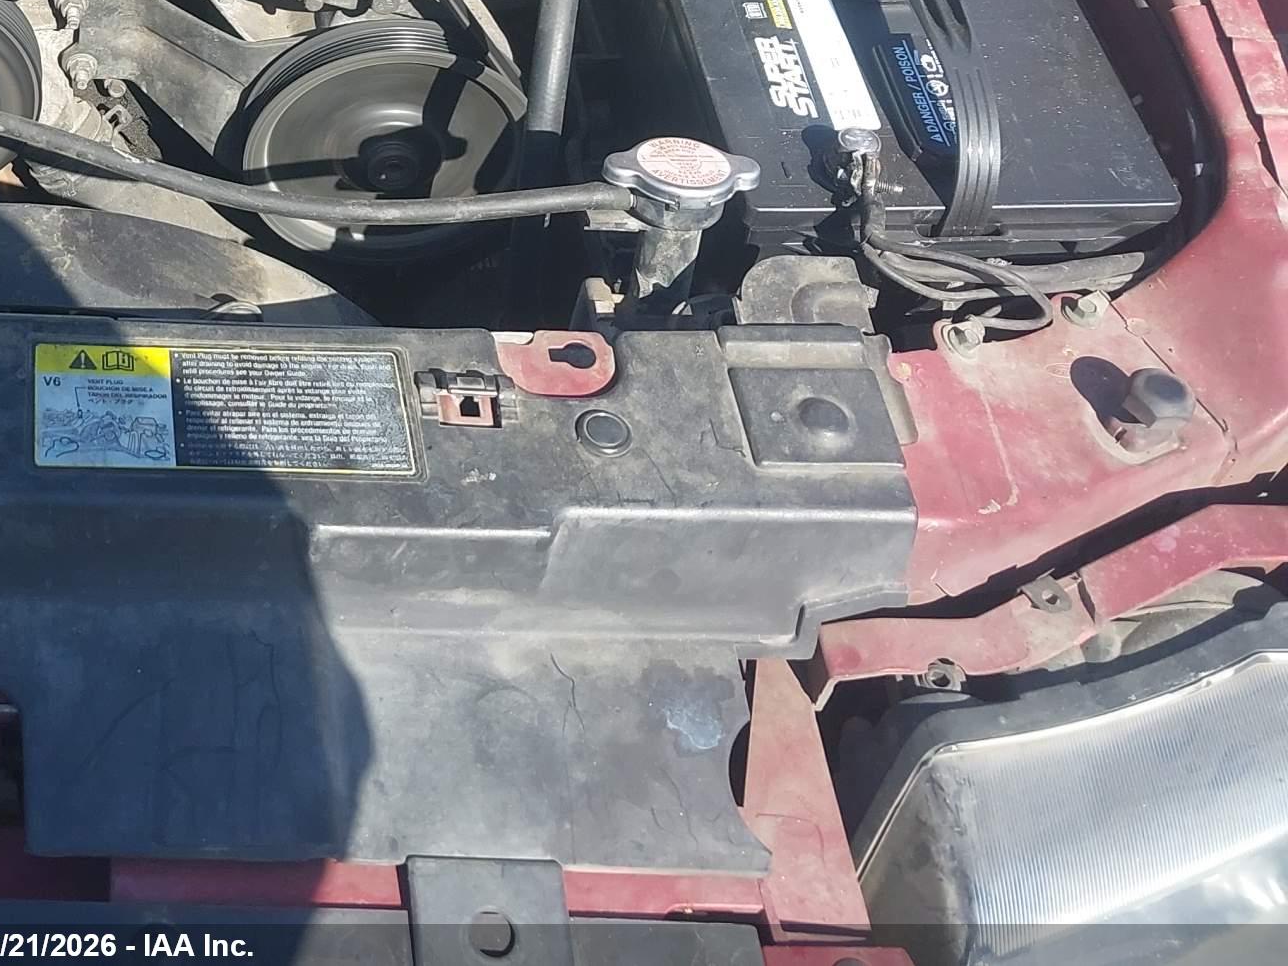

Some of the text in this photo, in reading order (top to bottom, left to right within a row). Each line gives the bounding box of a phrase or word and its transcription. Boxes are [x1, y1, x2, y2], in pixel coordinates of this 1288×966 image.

[754, 36, 794, 108] SUPER
[778, 42, 819, 118] START
[892, 46, 918, 82] POISON
[913, 92, 939, 133] DANGER
[648, 138, 701, 149] WARNING
[651, 169, 727, 185] AVERTISSEMENT
[43, 376, 61, 386] V6
